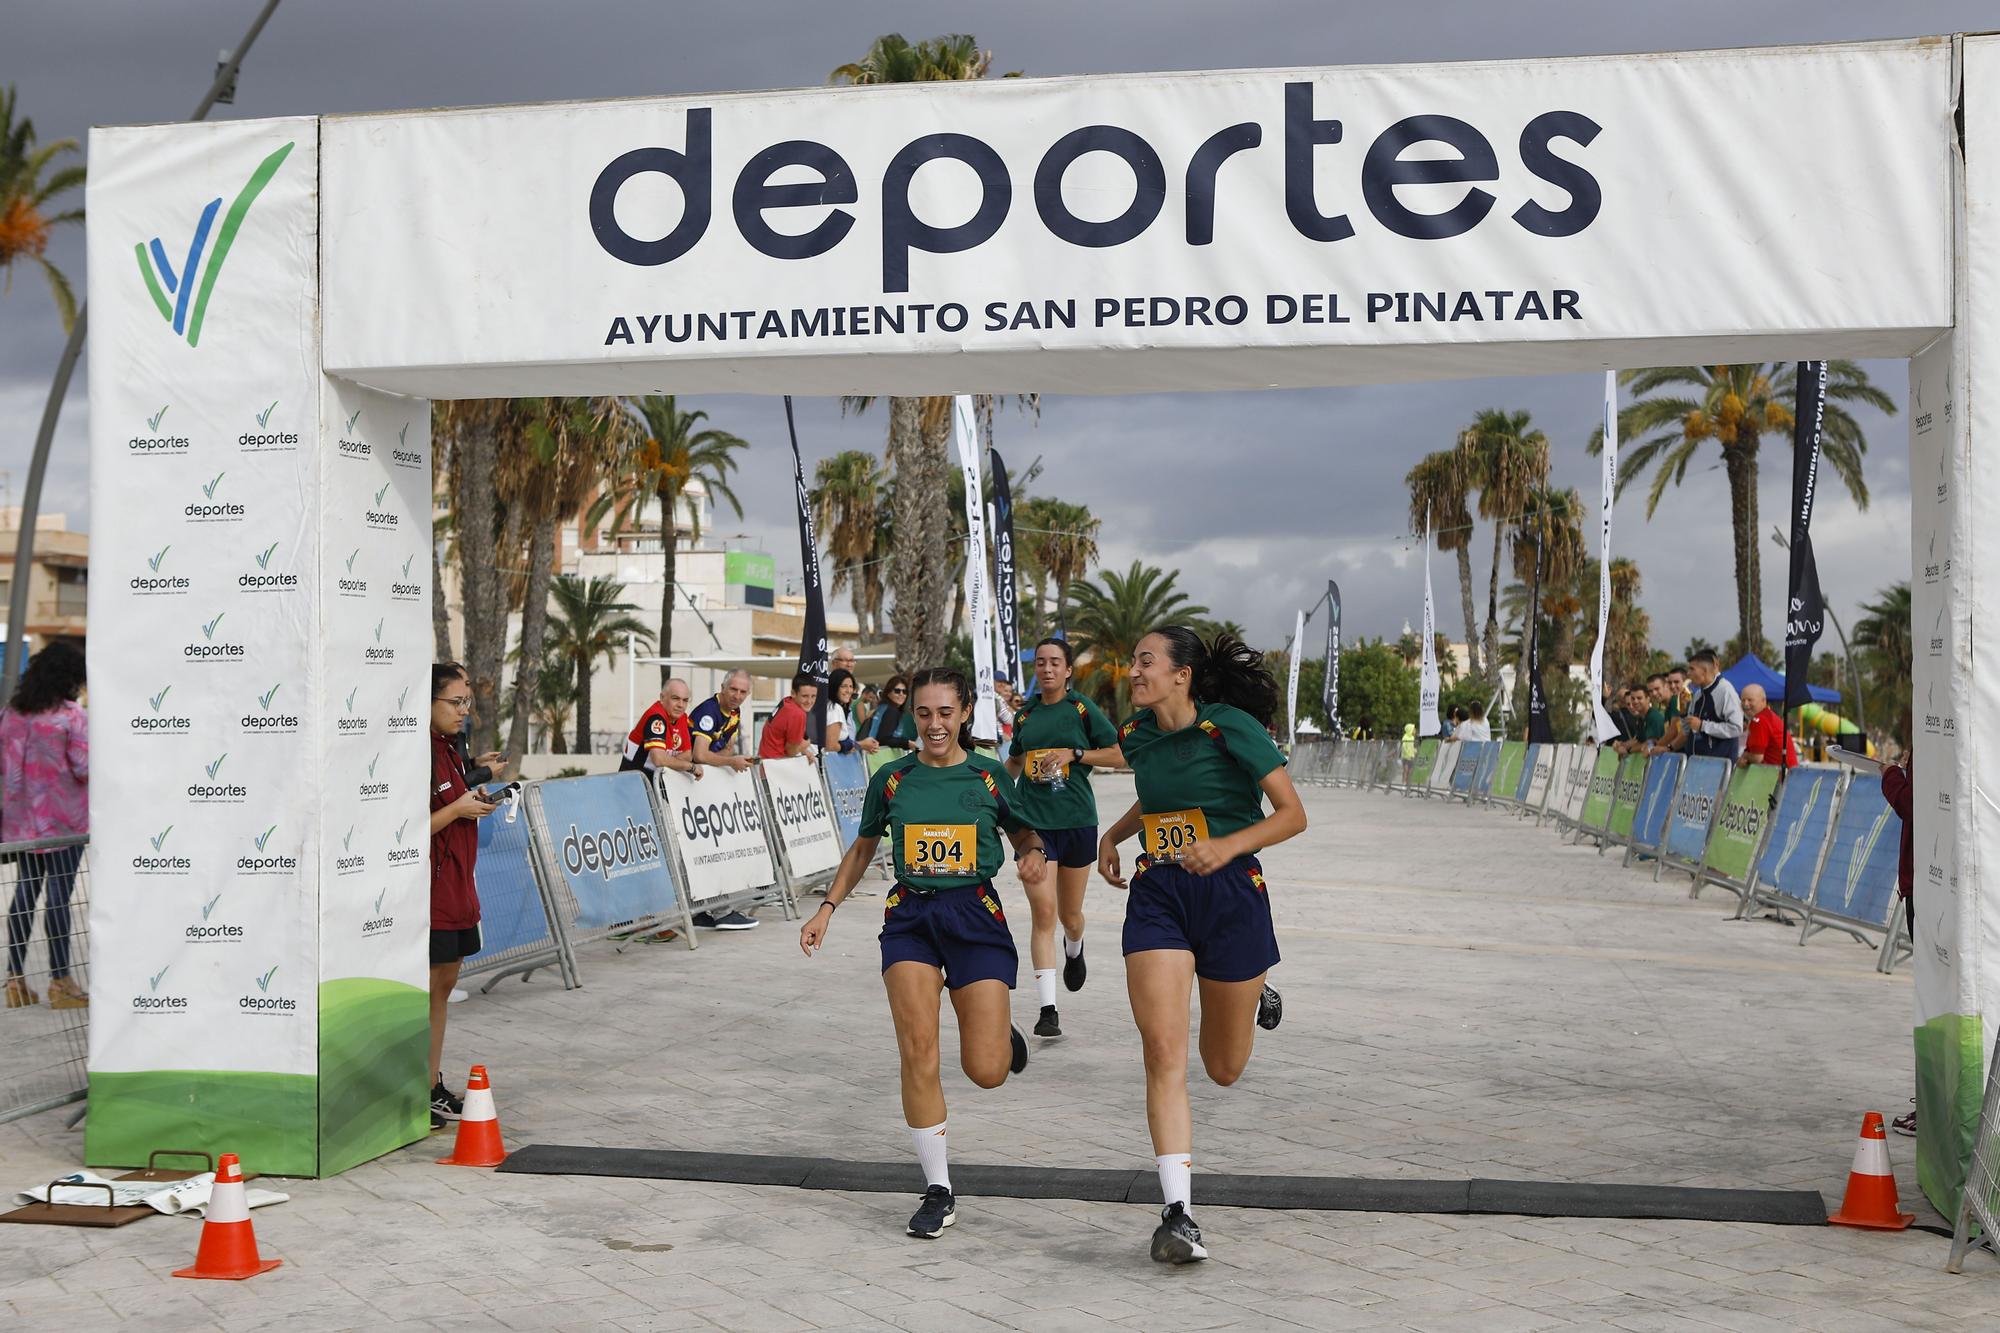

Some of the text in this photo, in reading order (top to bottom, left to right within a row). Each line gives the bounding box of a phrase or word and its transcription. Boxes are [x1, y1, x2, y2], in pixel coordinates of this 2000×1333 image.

[589, 82, 1602, 293] deportes
[605, 289, 1583, 345] AYUNTAMIENTO SAN PEDRO DEL PINATAR
[129, 435, 190, 451] deportes
[238, 431, 298, 448] deportes
[338, 438, 372, 455] deportes
[392, 448, 422, 464] deportes
[184, 502, 245, 518] deportes
[365, 509, 399, 526] deportes
[130, 575, 190, 592] deportes
[238, 572, 298, 588] deportes
[338, 577, 367, 592] deportes
[391, 581, 422, 597] deportes
[184, 643, 245, 659] deportes
[365, 645, 395, 661] deportes
[131, 715, 191, 731] deportes
[241, 714, 298, 730] deportes
[337, 715, 367, 730] deportes
[387, 713, 418, 729] deportes
[187, 783, 247, 800] deportes
[359, 782, 389, 797] deportes
[777, 784, 827, 833] deportes
[682, 792, 762, 847] deportes
[1156, 824, 1197, 850] 303
[387, 847, 420, 863] deportes
[563, 816, 660, 881] deportes
[916, 839, 964, 863] 304
[132, 855, 191, 871] deportes
[236, 855, 297, 872] deportes
[336, 854, 365, 870] deportes
[185, 924, 244, 940] deportes
[362, 916, 394, 932] deportes
[132, 995, 188, 1011] deportes
[238, 995, 297, 1012] deportes
